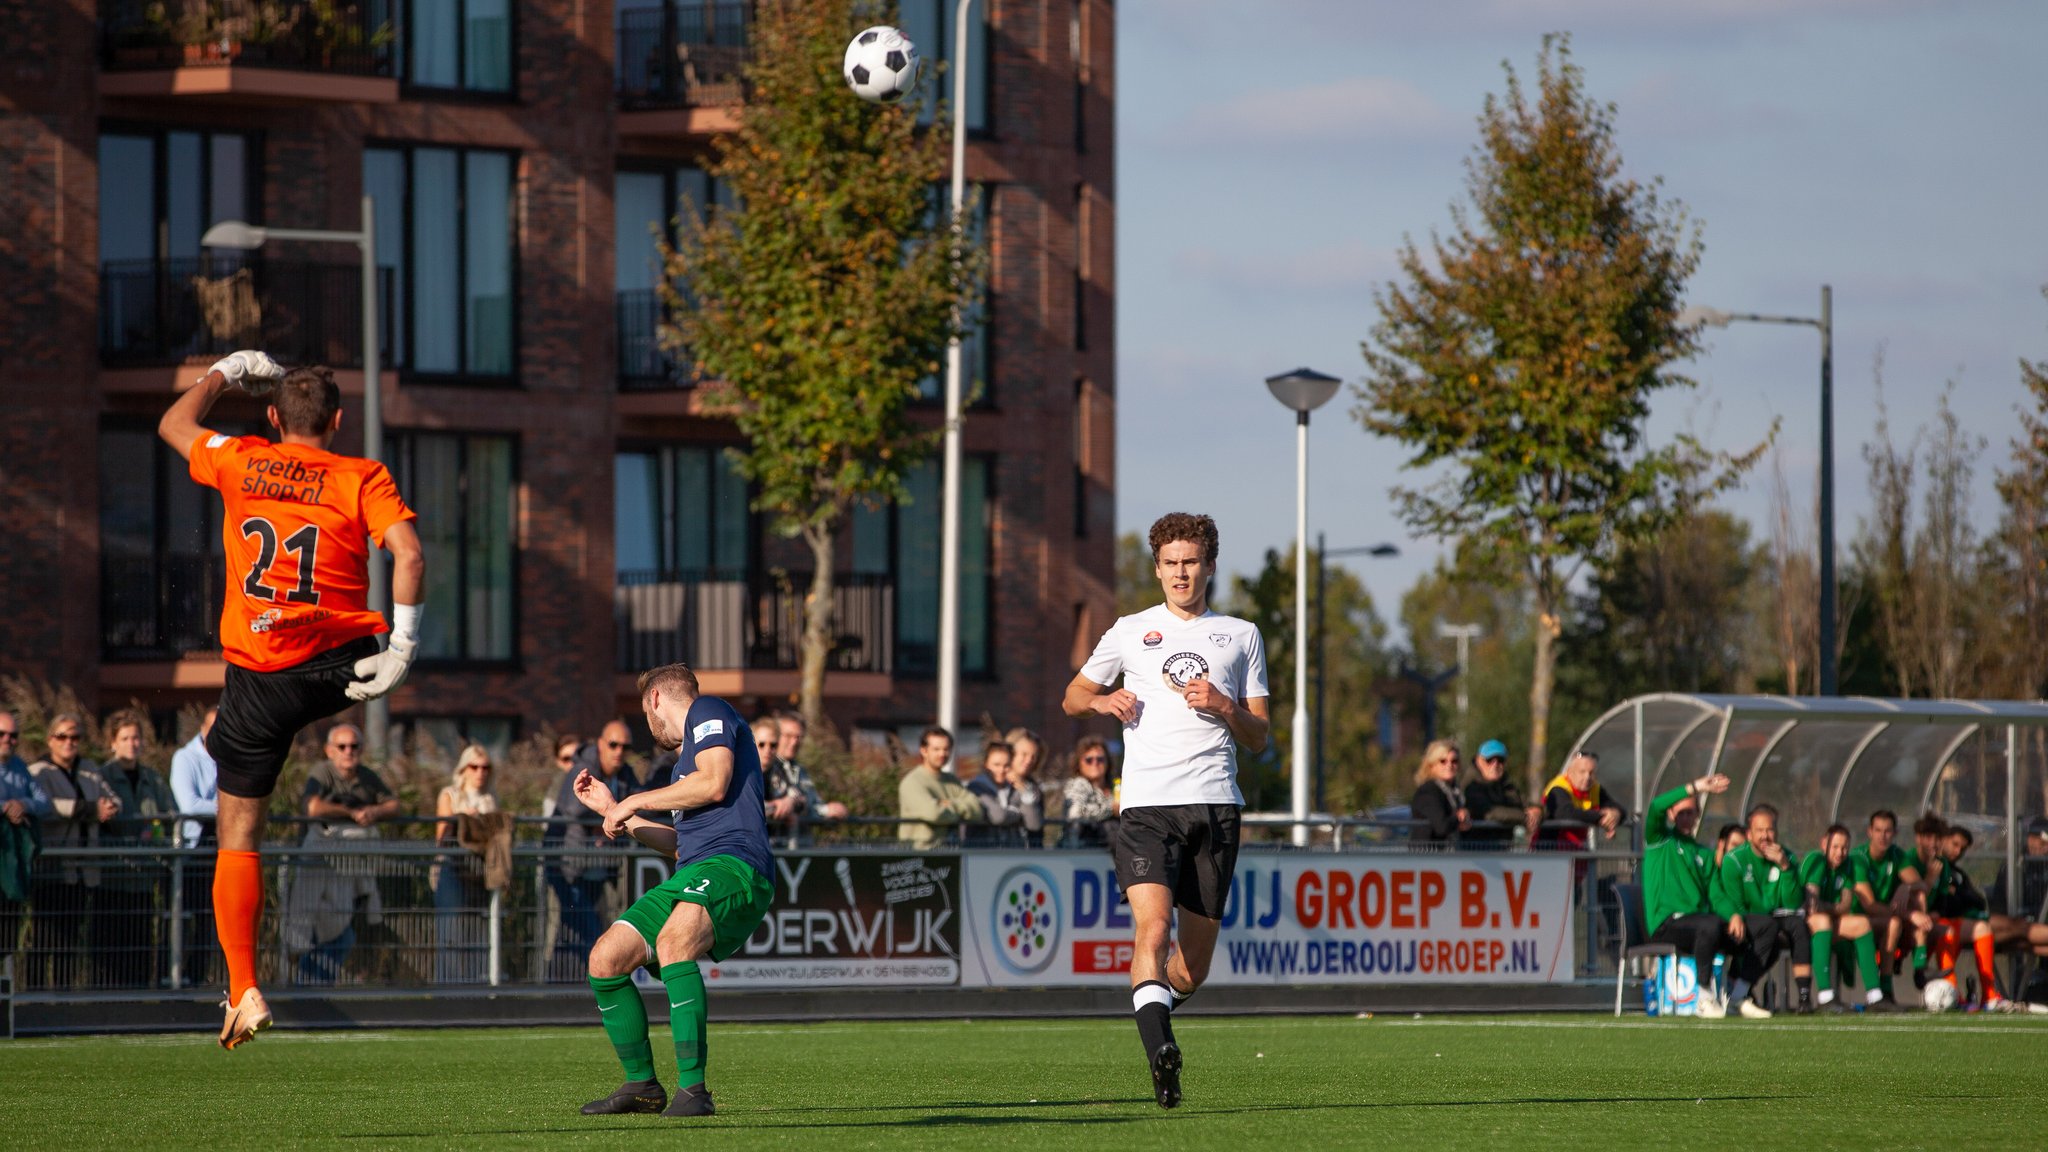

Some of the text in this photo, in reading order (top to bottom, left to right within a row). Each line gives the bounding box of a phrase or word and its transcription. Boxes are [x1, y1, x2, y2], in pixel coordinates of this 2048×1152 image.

[247, 456, 327, 484] voetbal
[241, 474, 324, 504] shop.nl
[240, 516, 320, 607] 21
[1163, 652, 1207, 670] BUSINESSCLUB
[695, 879, 710, 891] 2
[1295, 869, 1447, 929] GROEP
[1460, 870, 1540, 929] B.V.
[744, 908, 953, 955] DERWIJK
[1228, 939, 1540, 975] WWW.DEROOIJGROEP.NL
